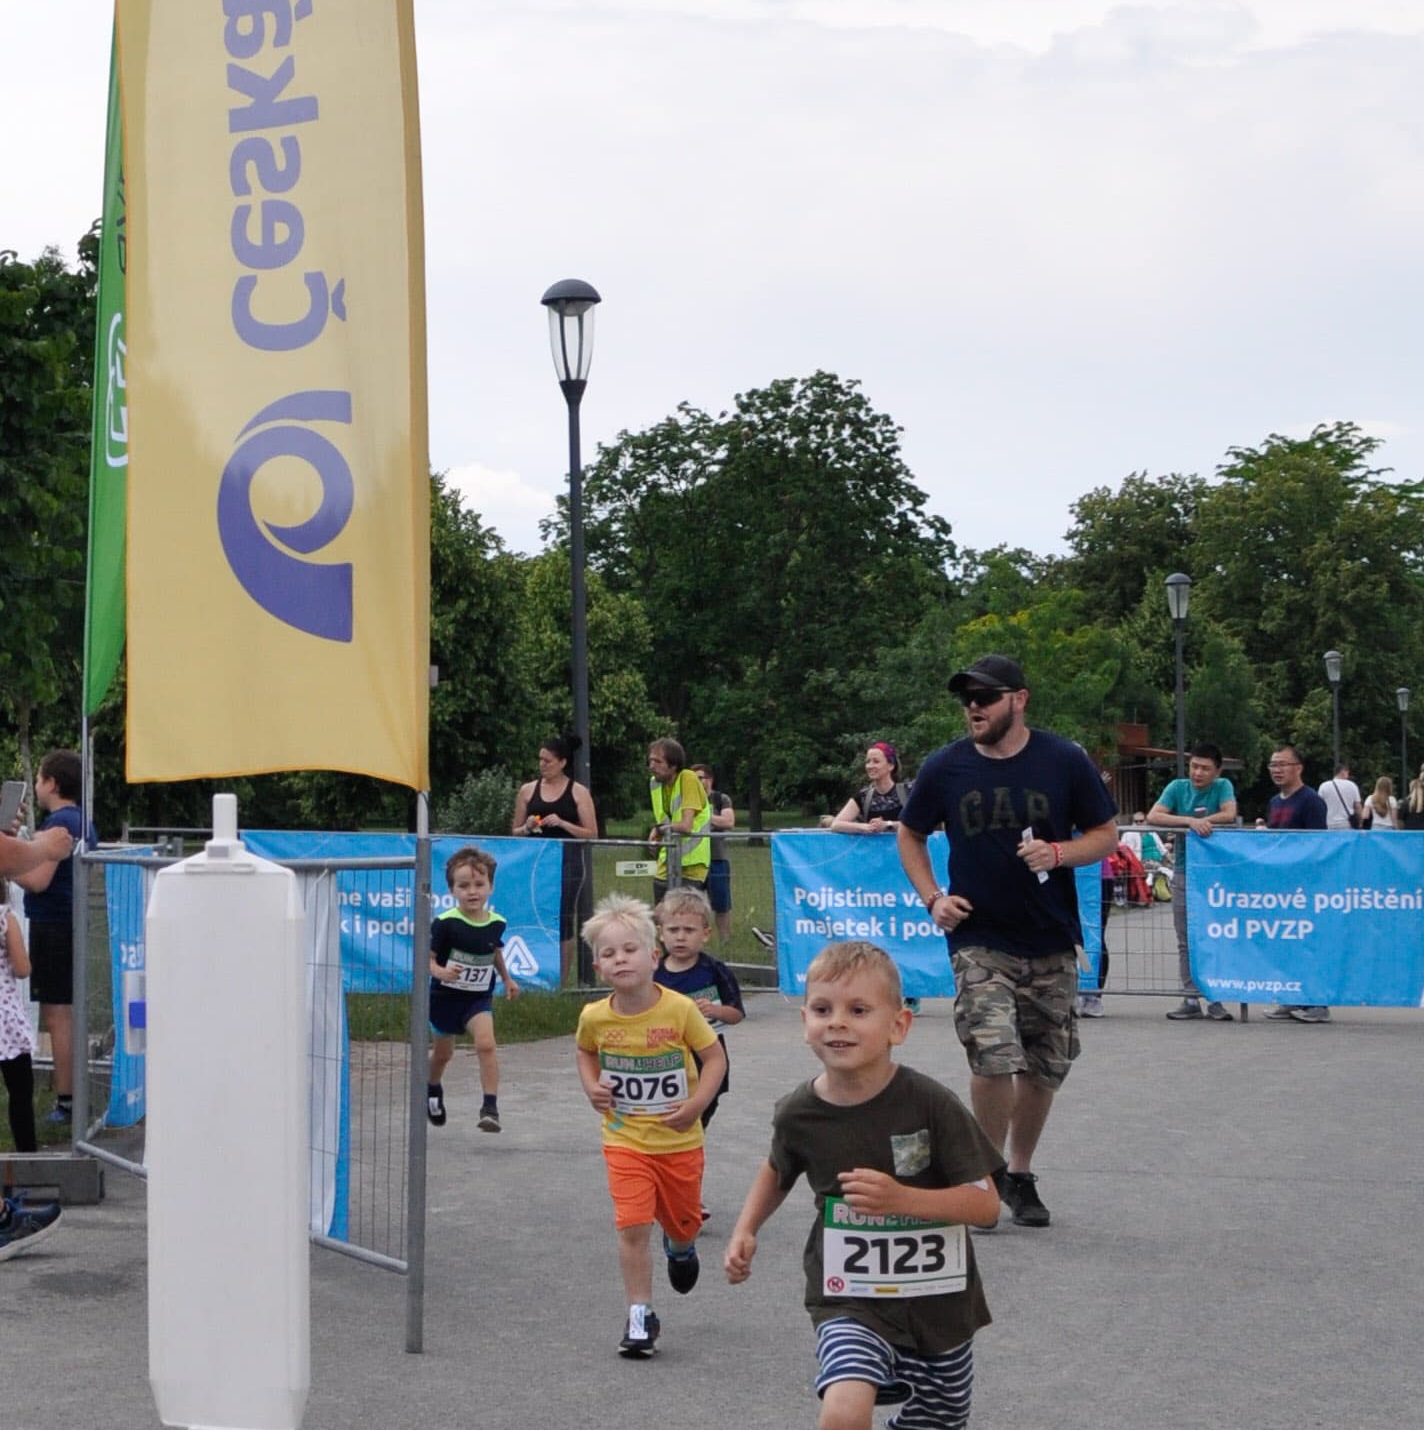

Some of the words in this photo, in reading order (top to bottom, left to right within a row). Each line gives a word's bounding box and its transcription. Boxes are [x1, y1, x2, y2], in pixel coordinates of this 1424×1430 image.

[960, 787, 1051, 836] GAP
[367, 886, 412, 908] vaši
[793, 886, 897, 912] Pojistíme
[1207, 882, 1307, 910] Úrazové
[1314, 887, 1424, 914] pojištění
[795, 916, 883, 940] majetek
[889, 916, 897, 937] i
[1207, 917, 1239, 940] od
[1245, 920, 1315, 940] PVZP
[1207, 977, 1303, 992] www.pvzp.cz
[609, 1073, 680, 1101] 2076
[843, 1234, 946, 1275] 2123
